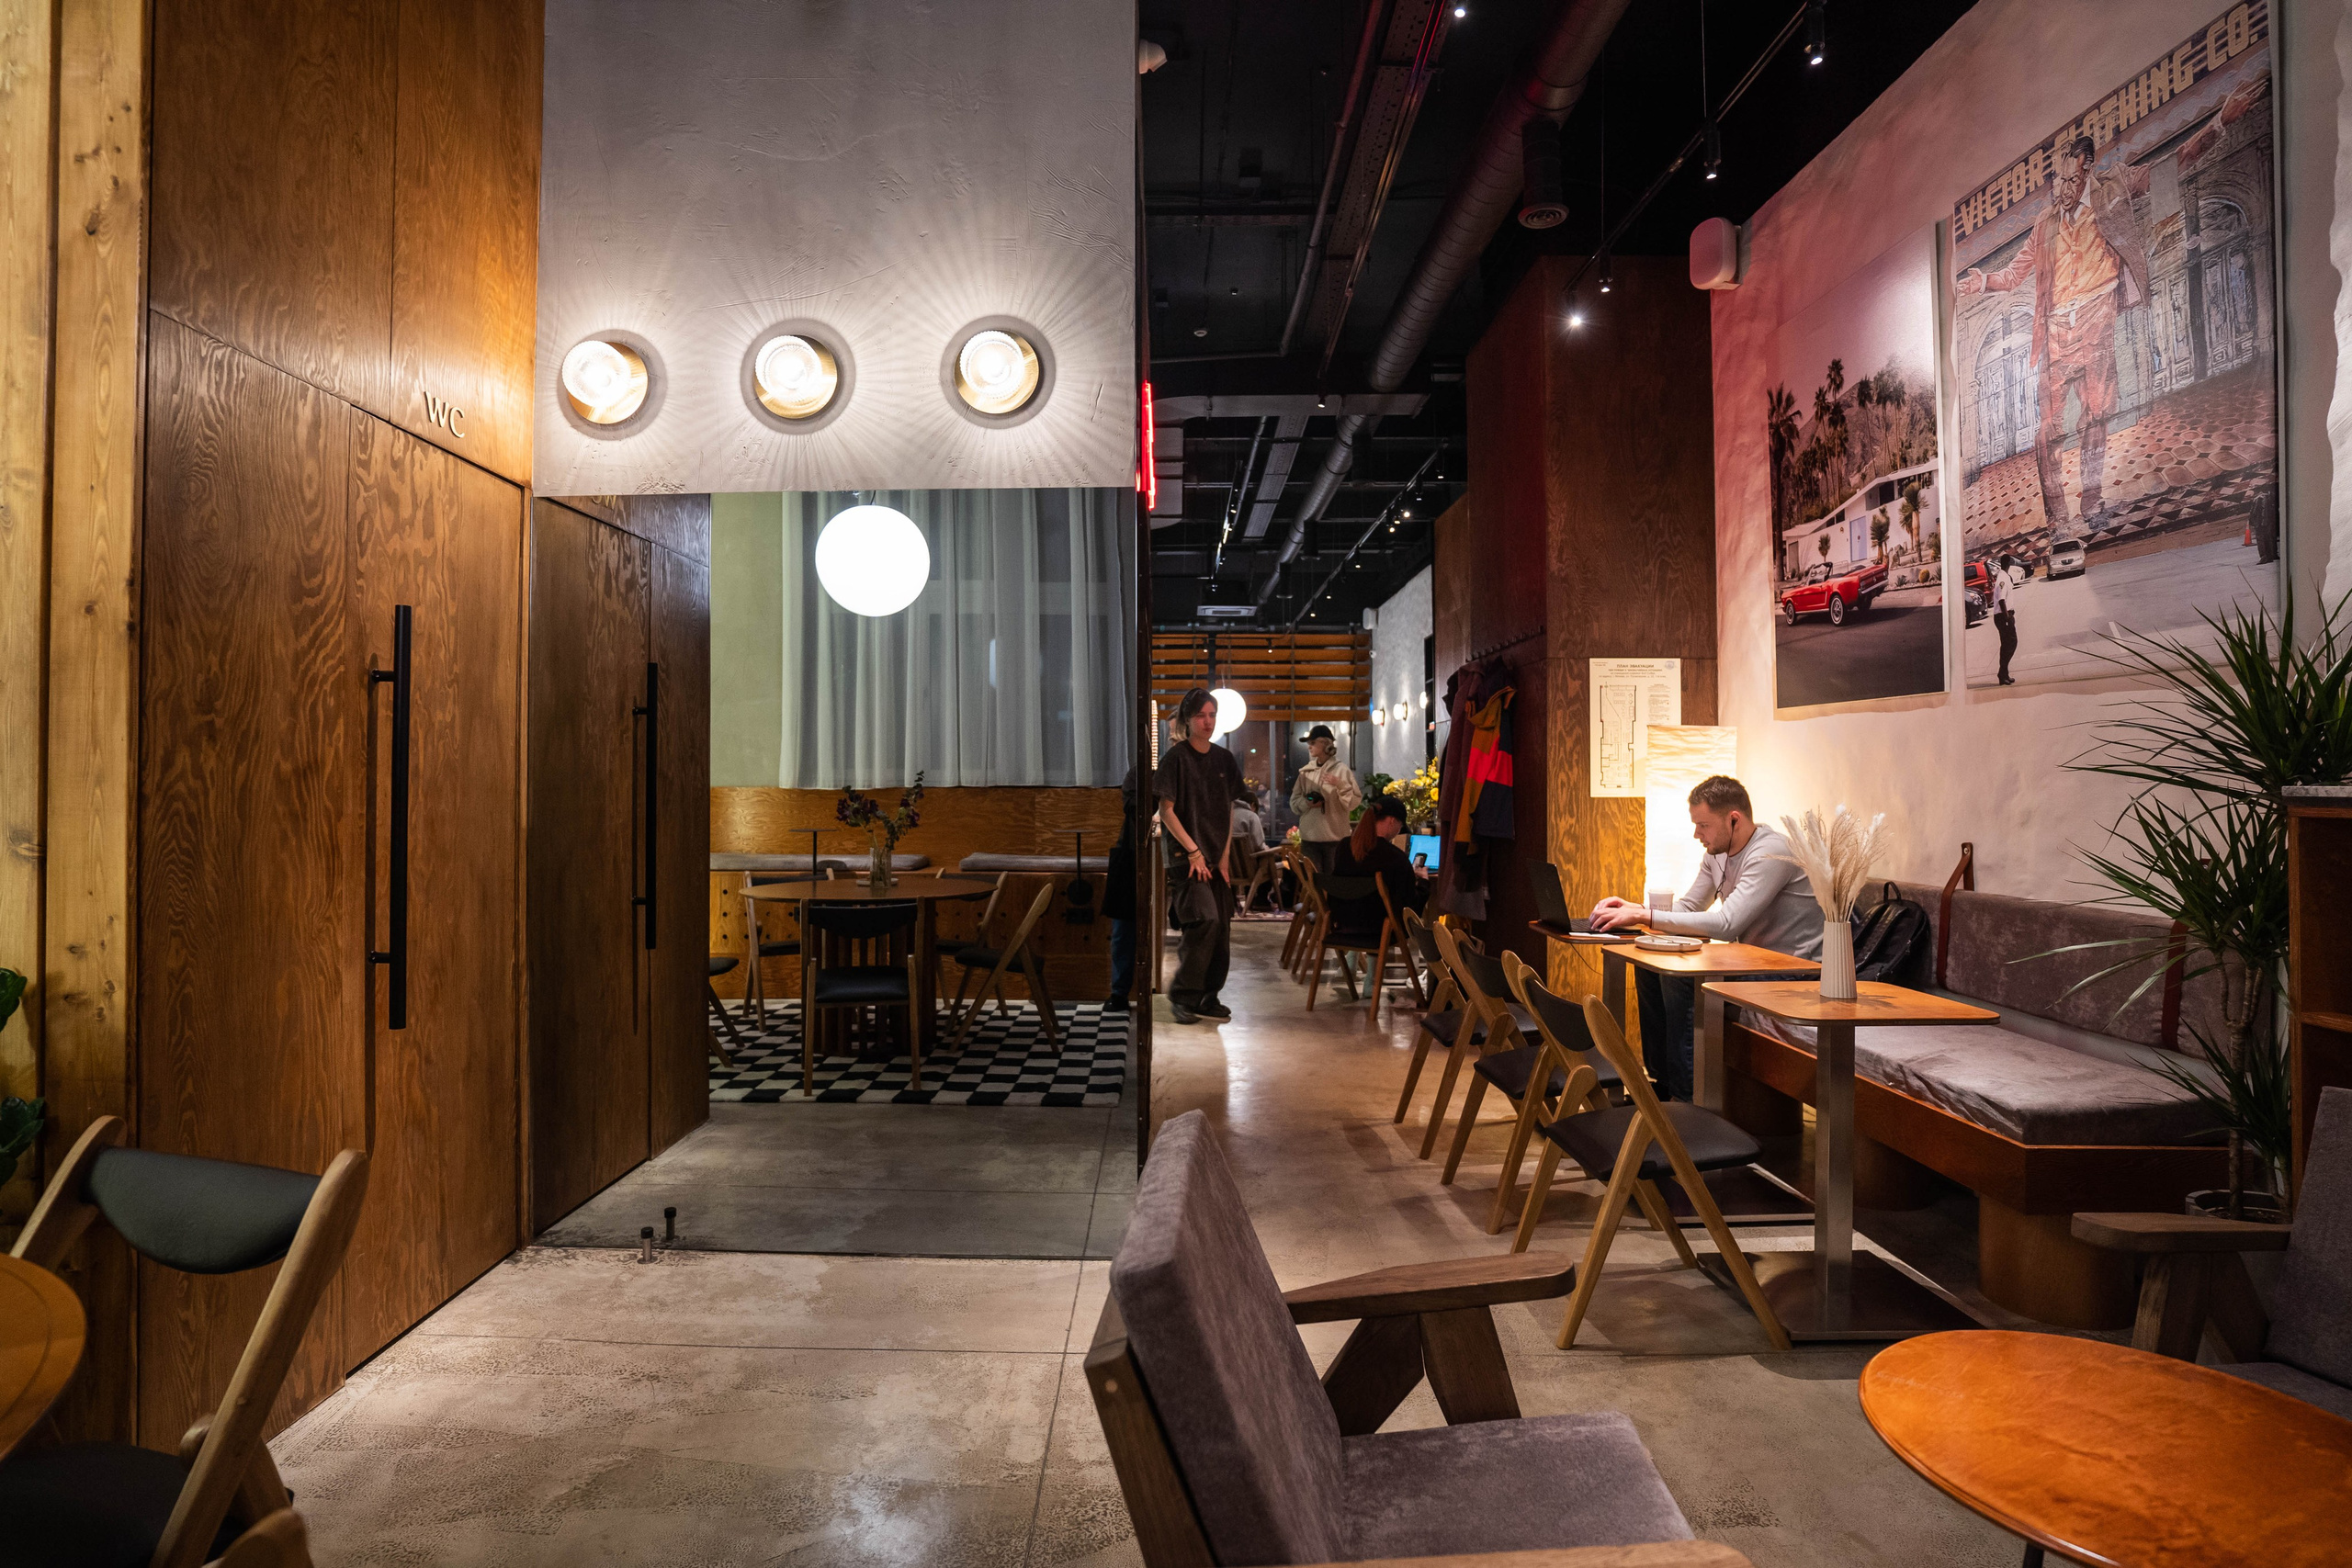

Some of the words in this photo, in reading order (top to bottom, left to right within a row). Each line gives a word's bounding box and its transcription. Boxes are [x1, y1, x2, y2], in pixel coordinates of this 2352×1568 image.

[1960, 148, 2045, 236] VICTOR
[2207, 3, 2258, 72] CO.
[424, 390, 465, 438] WC
